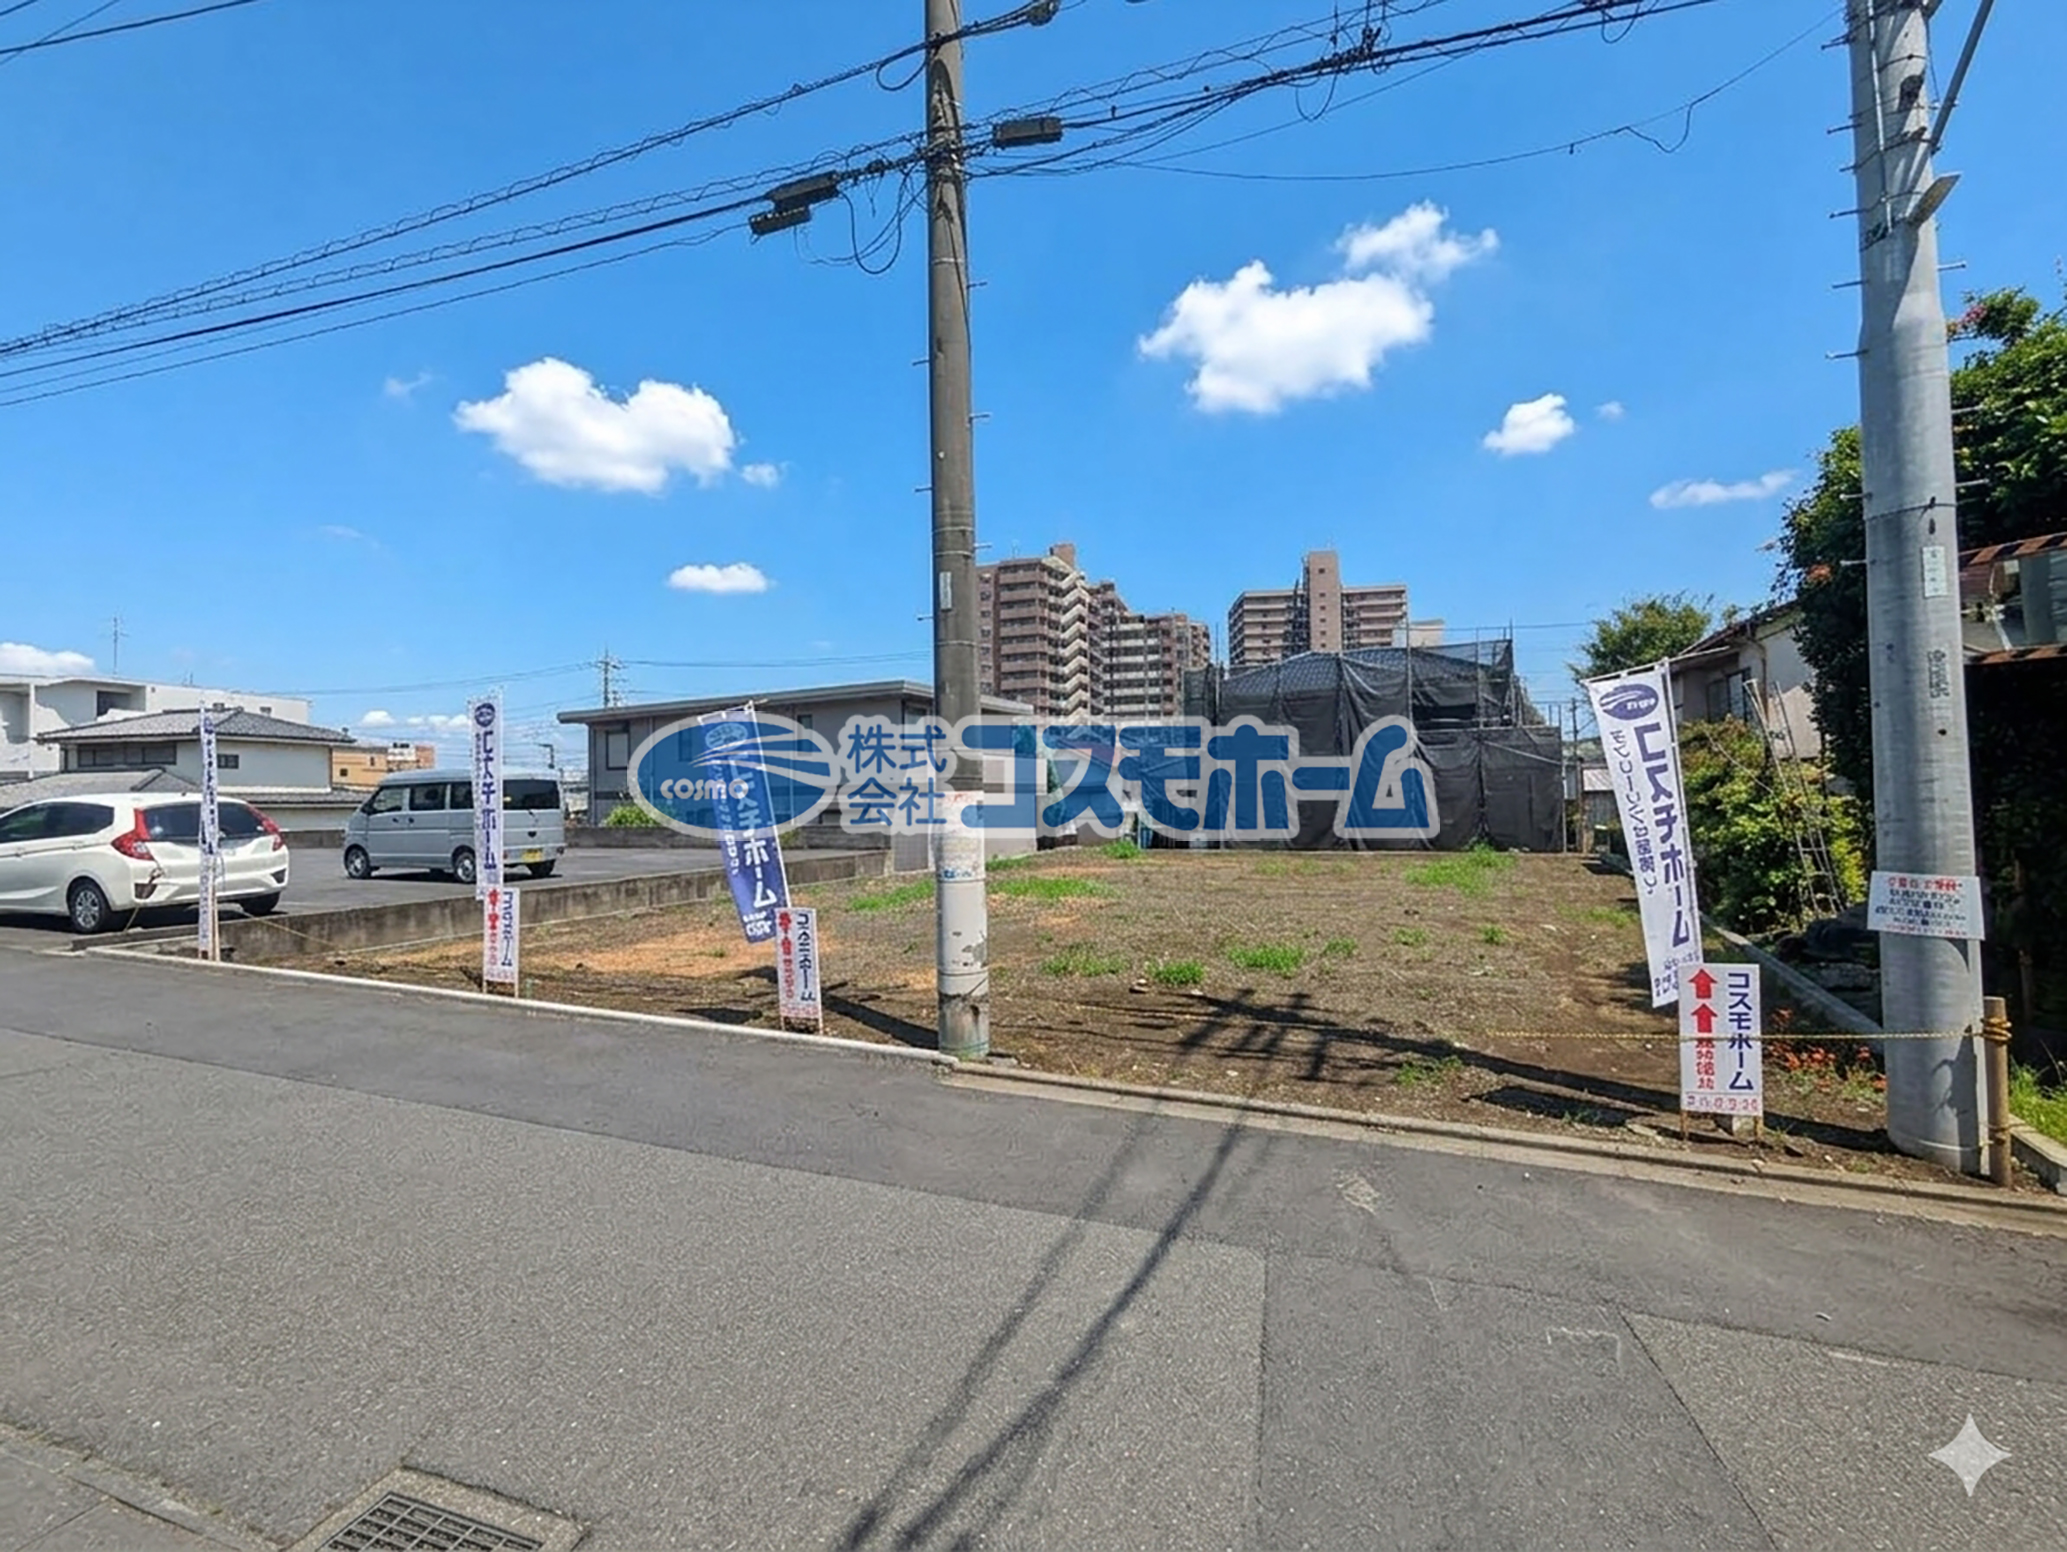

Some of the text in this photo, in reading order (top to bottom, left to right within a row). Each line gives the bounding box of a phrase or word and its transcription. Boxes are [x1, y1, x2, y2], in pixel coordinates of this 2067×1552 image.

[1727, 971, 1754, 1091] コスモホーム
